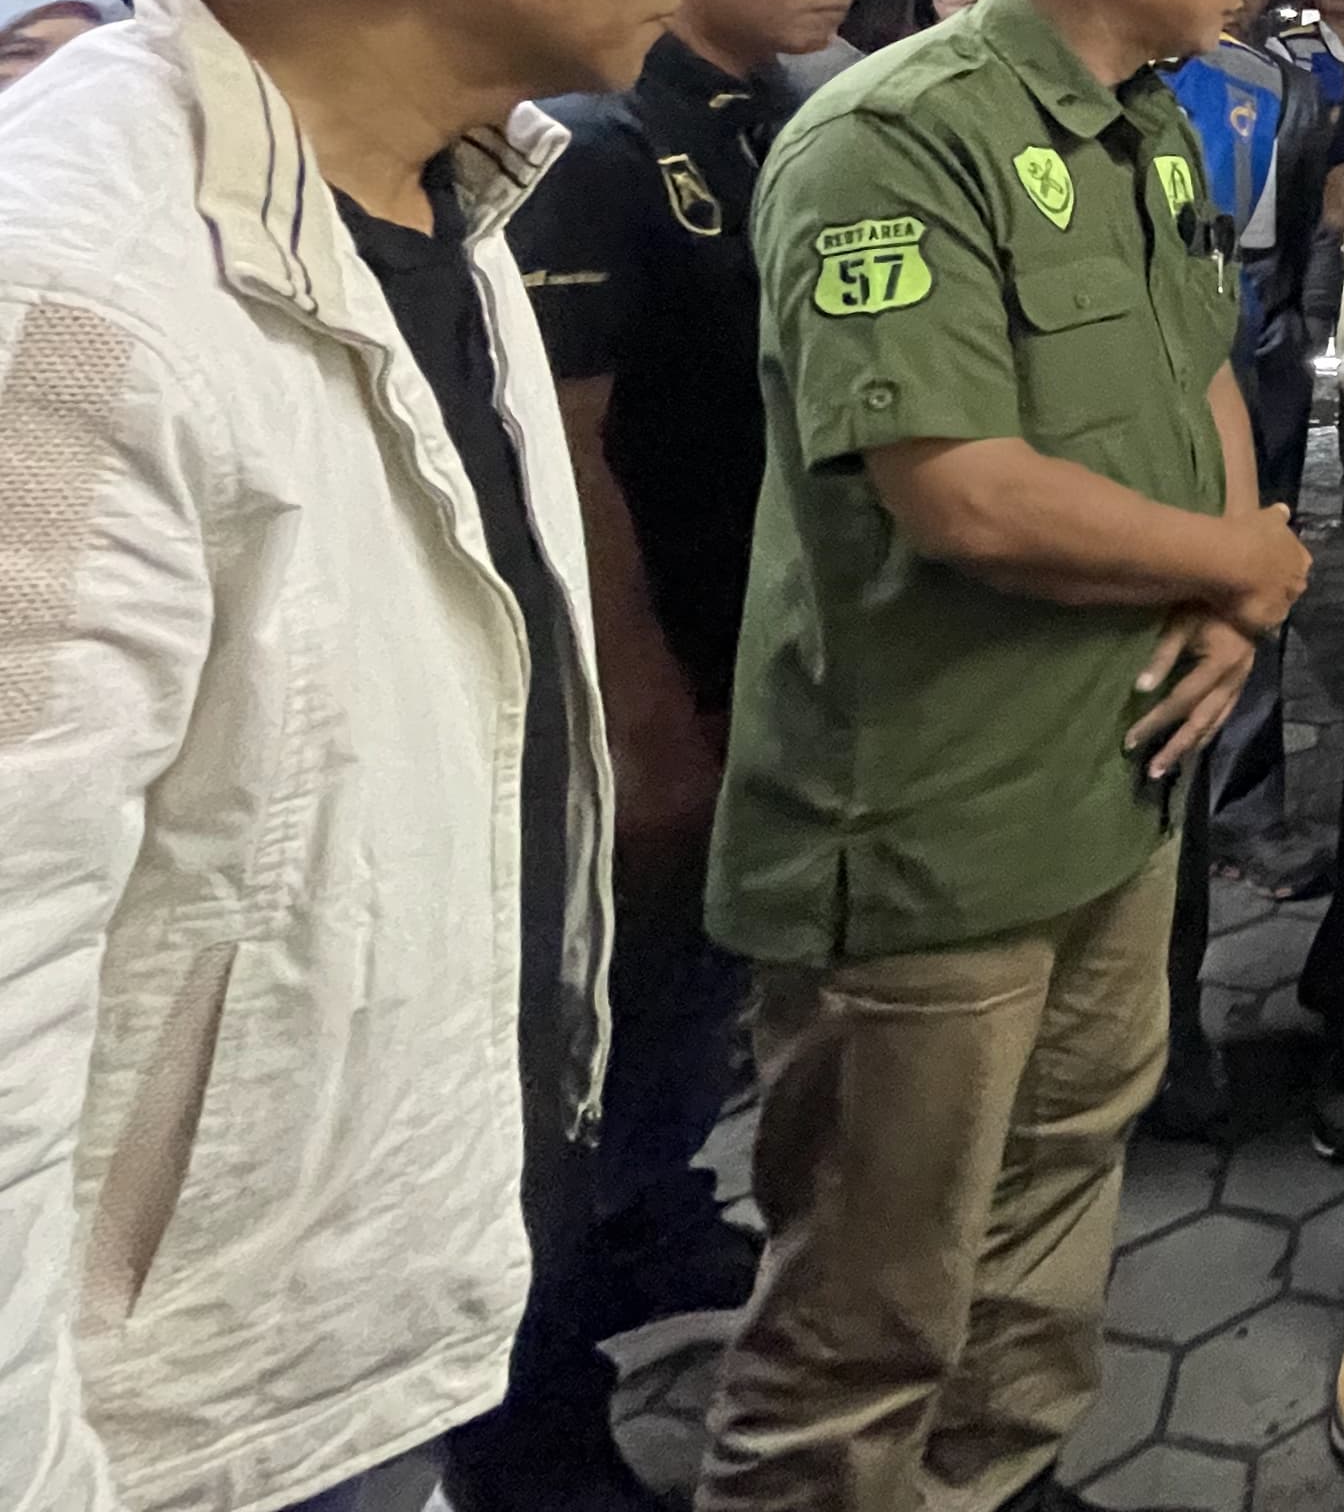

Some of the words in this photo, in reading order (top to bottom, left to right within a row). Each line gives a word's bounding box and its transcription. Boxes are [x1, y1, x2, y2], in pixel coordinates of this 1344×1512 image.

[823, 228, 864, 250] REST
[868, 222, 915, 241] AREA
[839, 254, 904, 306] 57
